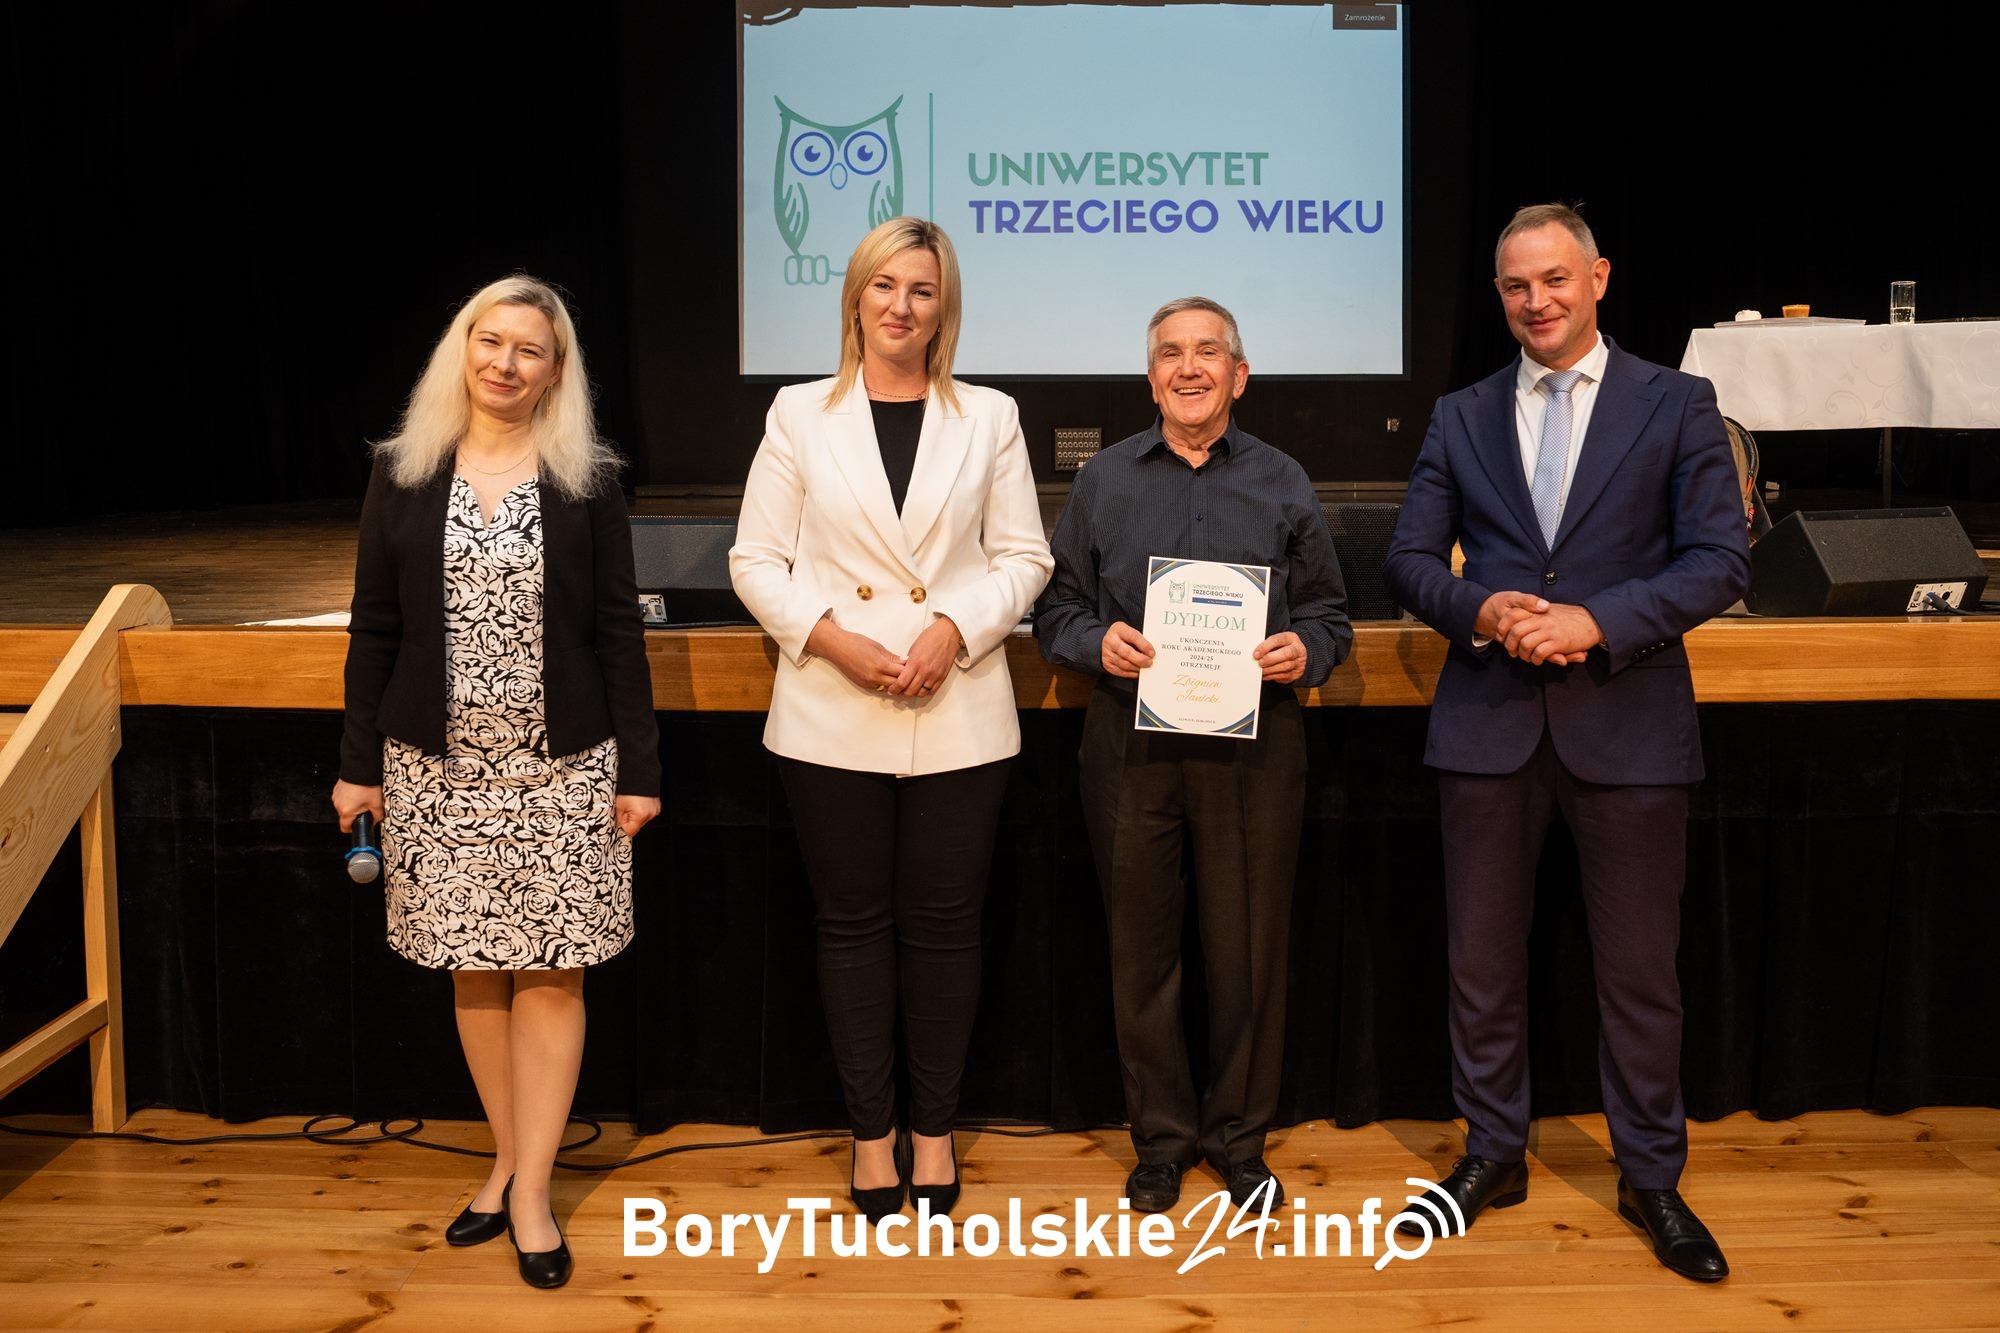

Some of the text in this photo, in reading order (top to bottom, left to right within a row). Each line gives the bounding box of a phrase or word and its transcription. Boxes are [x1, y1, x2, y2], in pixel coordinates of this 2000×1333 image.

[968, 152, 1269, 186] UNIWERSYTET
[968, 199, 1384, 234] TRZECIEGO WIEKU
[1192, 589, 1224, 597] TRZECIEGO
[1163, 610, 1247, 631] DYPLOM
[1183, 645, 1242, 656] AKADEMICKIEGO
[1180, 661, 1222, 671] OTRZYMUJE
